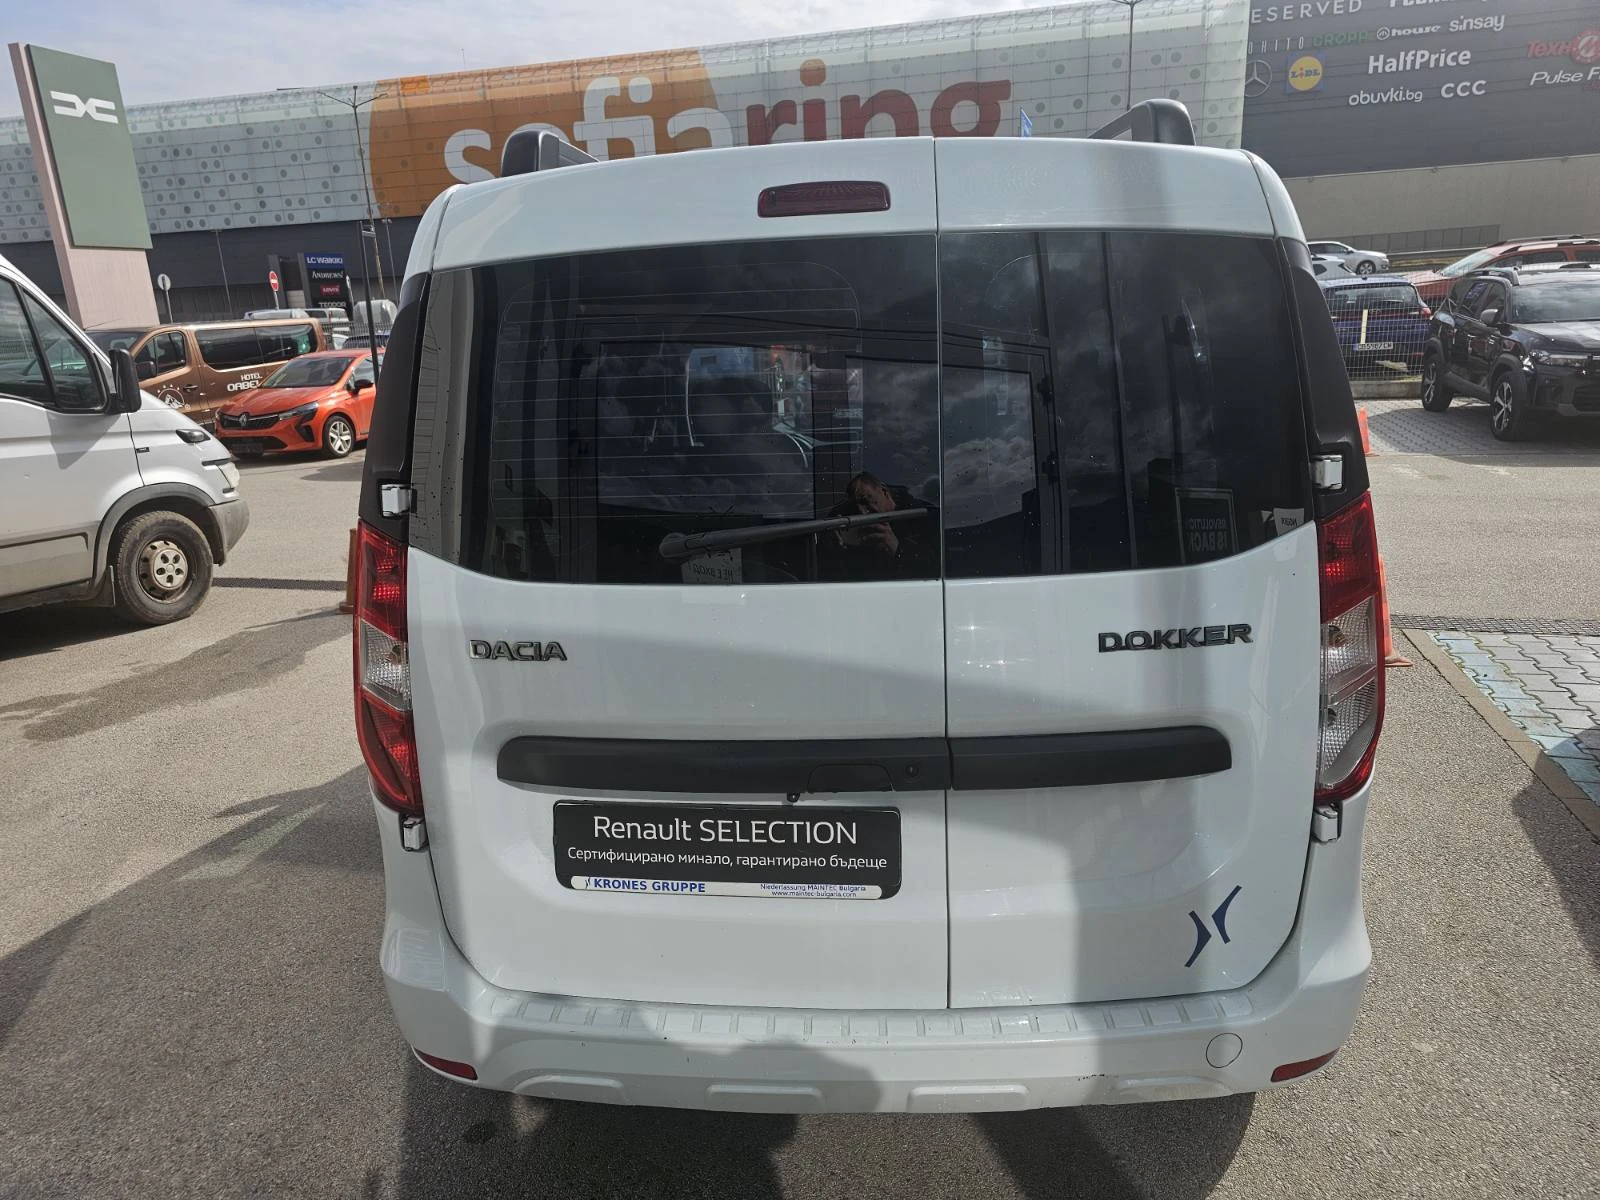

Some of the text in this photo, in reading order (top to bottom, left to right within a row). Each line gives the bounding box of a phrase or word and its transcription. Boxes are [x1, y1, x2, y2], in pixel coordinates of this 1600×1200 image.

[1368, 48, 1472, 74] HalfPrice
[1530, 67, 1600, 86] Pulse F
[1348, 86, 1423, 106] obuvki.bg
[1441, 80, 1487, 98] CCC
[240, 372, 263, 381] HOTEL
[1098, 624, 1253, 652] DOKKER
[469, 640, 567, 661] DACIA
[594, 816, 857, 845] Renault SELECTION
[567, 847, 888, 870] Сертифицирано минало, гарантирано бъдеще
[594, 878, 706, 893] KRONES GRUPPE
